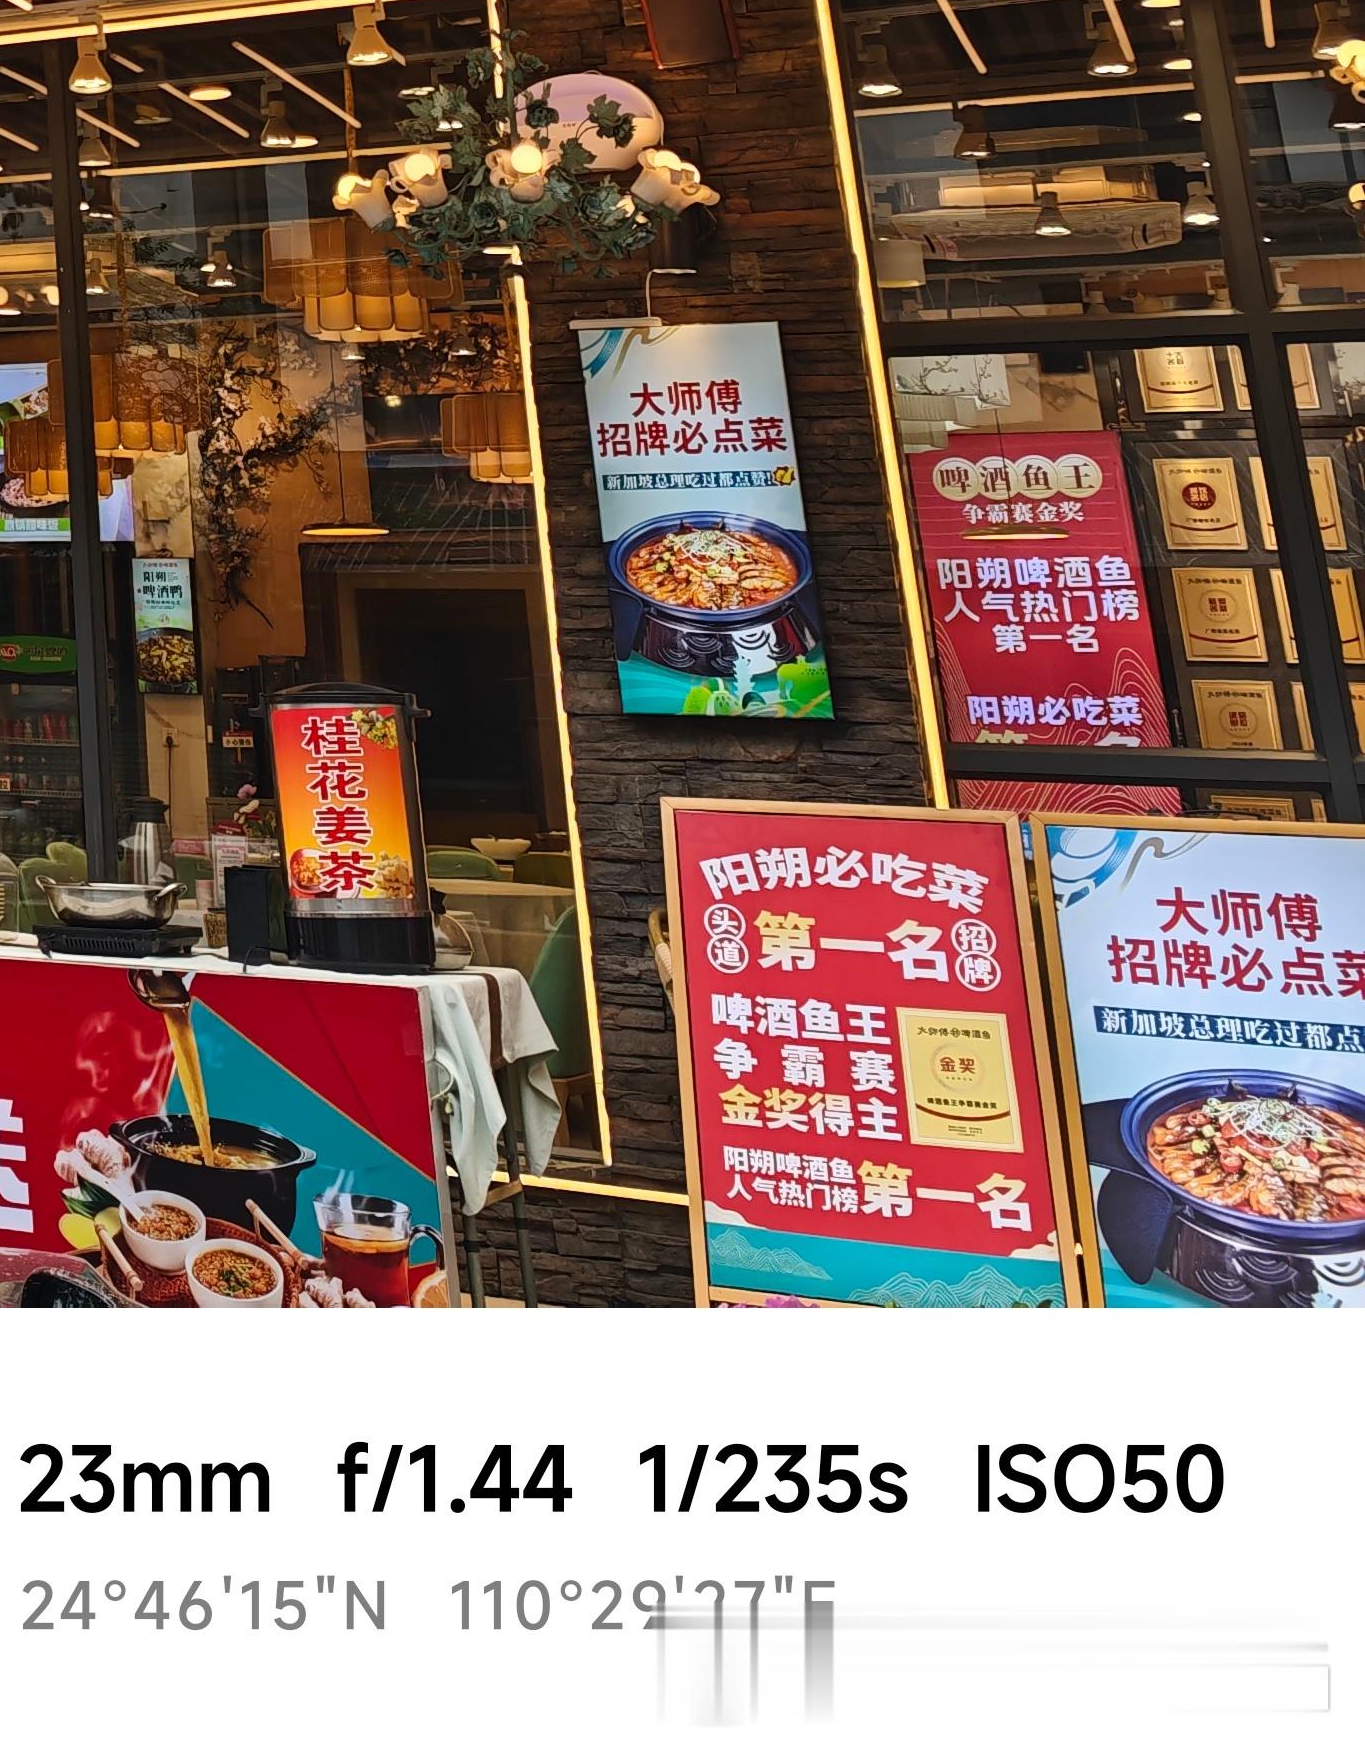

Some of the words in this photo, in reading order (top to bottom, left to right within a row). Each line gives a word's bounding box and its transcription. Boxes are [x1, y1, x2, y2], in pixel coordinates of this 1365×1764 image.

[629, 378, 743, 419] 大师傅
[596, 416, 789, 458] 招牌必点菜
[937, 462, 1098, 494] 啤酒鱼王
[961, 501, 1086, 525] 争霸赛金奖
[937, 554, 1138, 591] 阳朔啤酒鱼
[943, 589, 1141, 624] 人气热门榜
[992, 623, 1101, 654] 第一名
[966, 693, 1144, 728] 阳朔必吃菜
[301, 715, 378, 894] 桂花姜茶
[698, 844, 990, 914] 阳朔必吃菜
[1155, 886, 1324, 942] 大师傅
[711, 907, 744, 969] 头道
[753, 909, 949, 983] 第一名
[958, 924, 995, 987] 招牌
[1106, 935, 1365, 1001] 招牌必点菜
[710, 992, 892, 1046] 啤酒鱼王
[939, 1056, 976, 1075] 金奖
[717, 1083, 903, 1142] 金奖得主
[723, 1145, 857, 1186] 阳朔啤酒鱼
[726, 1178, 859, 1216] 人气热门榜
[856, 1159, 1033, 1233] 第一名
